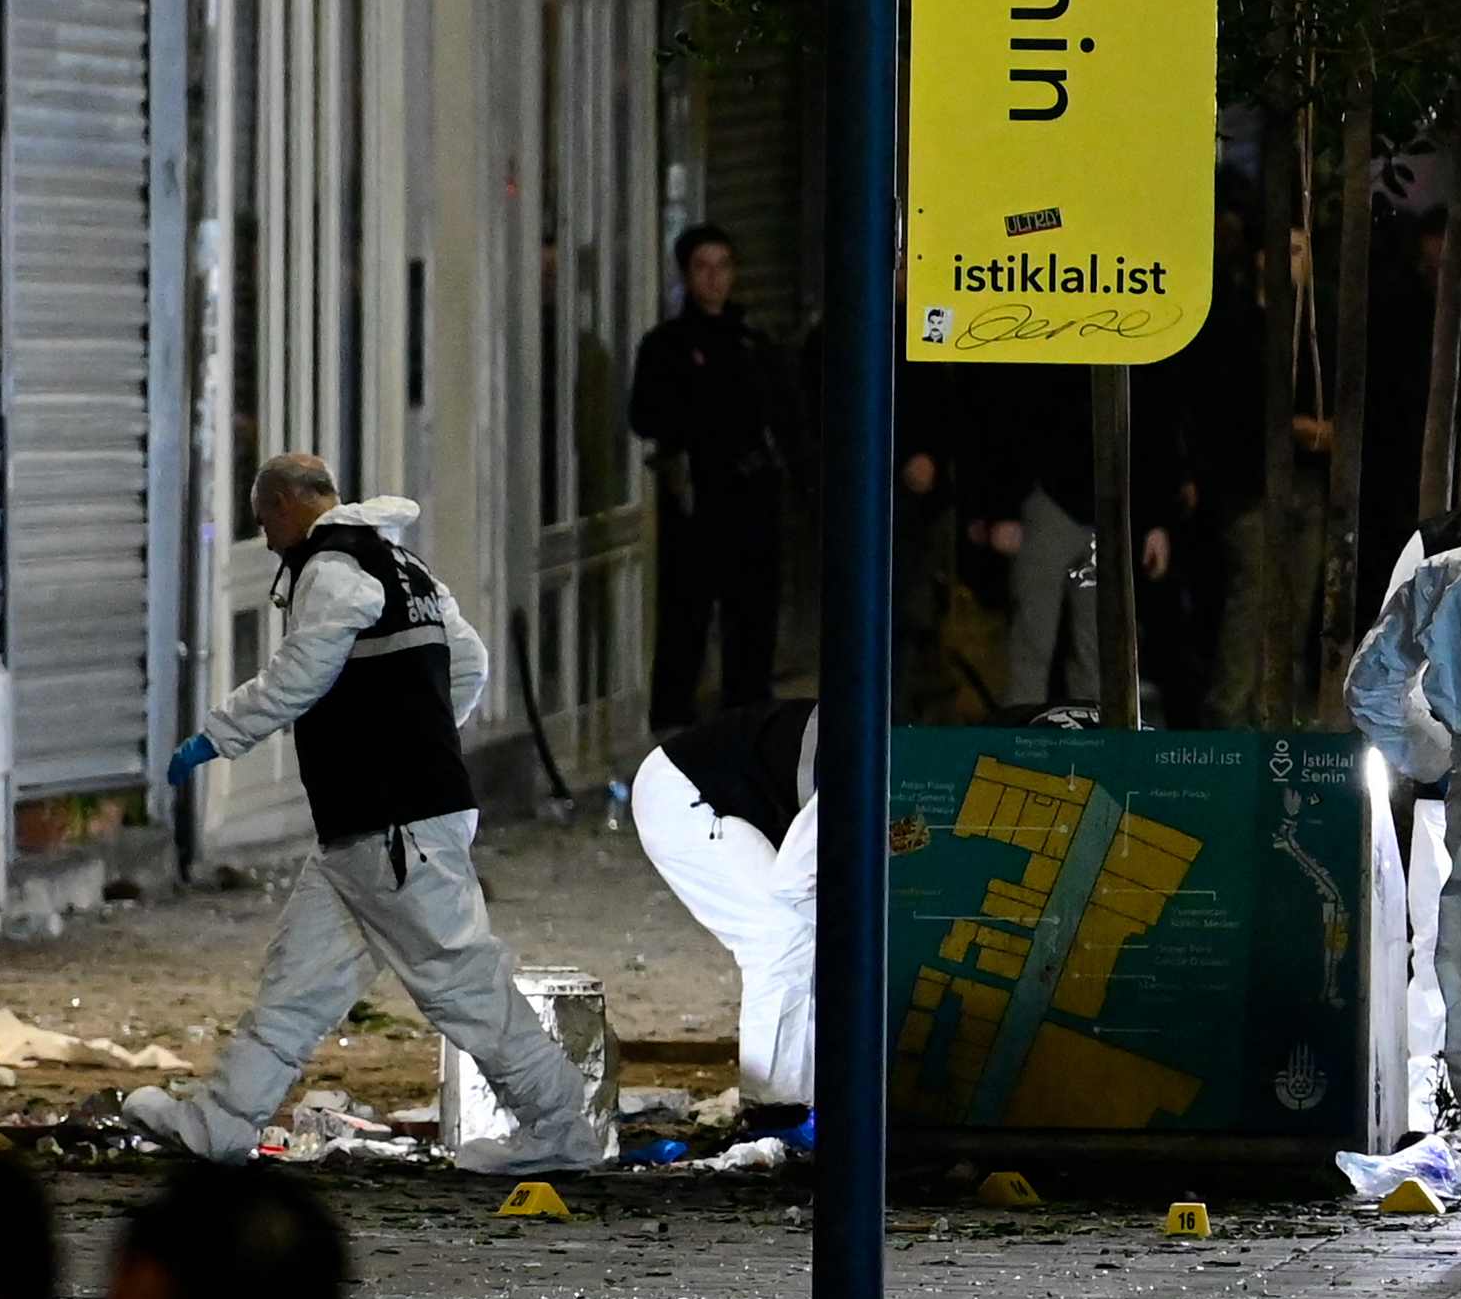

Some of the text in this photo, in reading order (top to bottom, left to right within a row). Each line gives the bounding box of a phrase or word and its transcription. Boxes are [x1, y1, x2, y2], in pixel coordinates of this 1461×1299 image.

[953, 252, 1167, 295] istiklal.ist
[1300, 768, 1347, 784] Senin
[1178, 1212, 1196, 1230] 16
